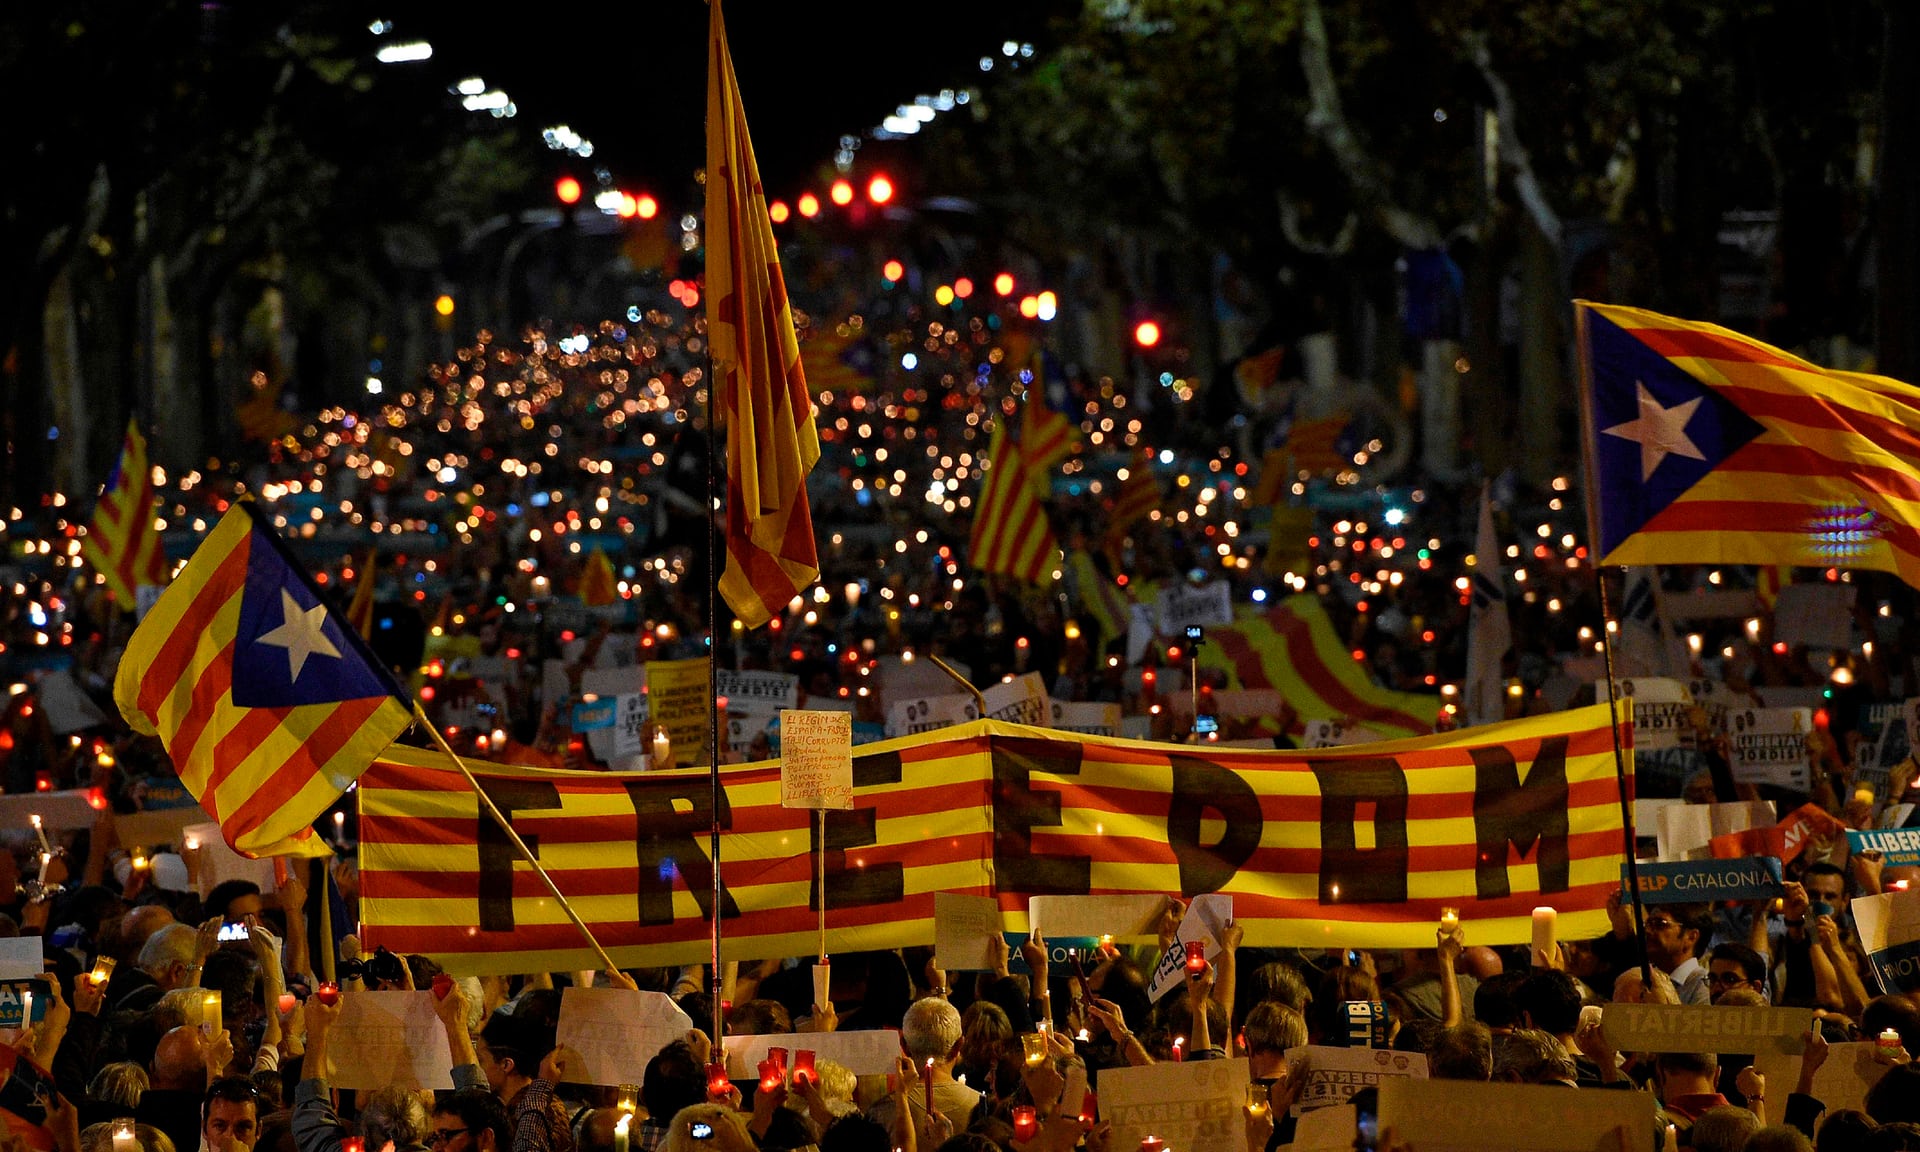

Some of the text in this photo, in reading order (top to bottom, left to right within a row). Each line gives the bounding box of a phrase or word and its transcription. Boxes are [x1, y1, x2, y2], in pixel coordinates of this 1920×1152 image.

[478, 737, 1570, 932] FREEDOM
[1859, 831, 1920, 852] LLIBER
[1673, 871, 1774, 890] CATALONIA
[1345, 1000, 1372, 1049] LLIB
